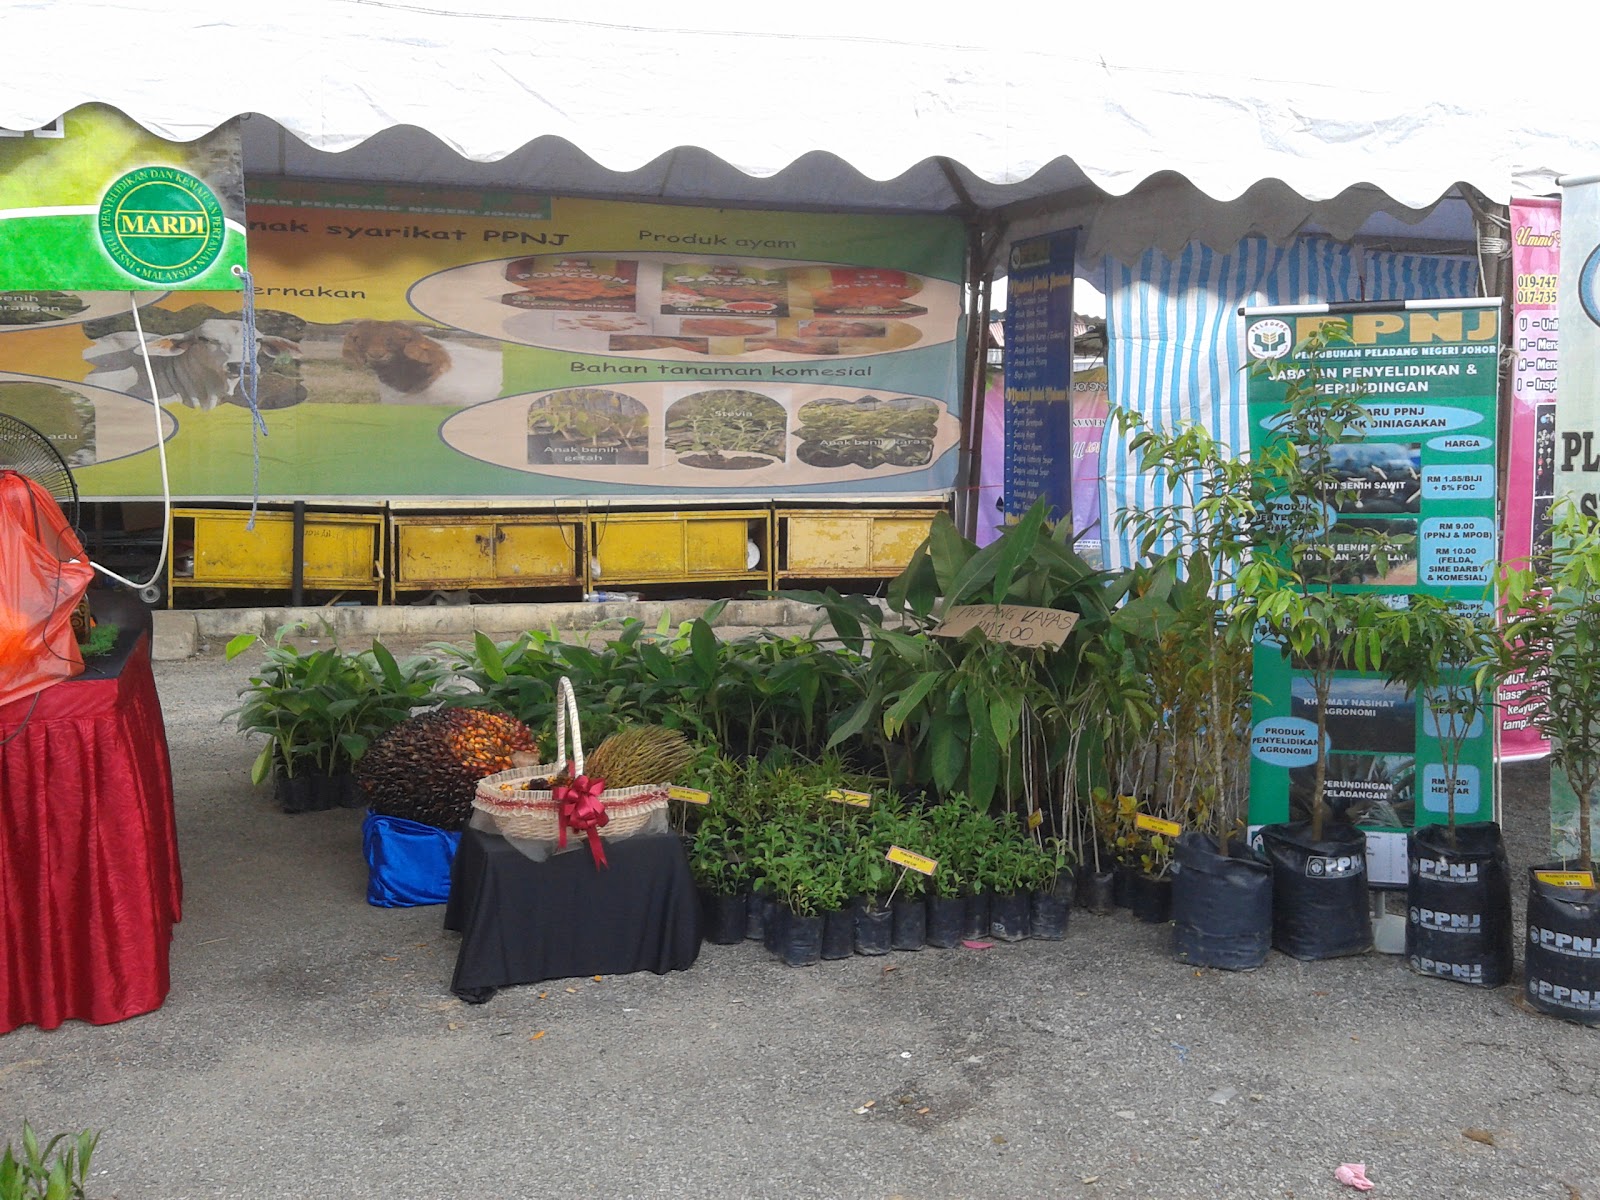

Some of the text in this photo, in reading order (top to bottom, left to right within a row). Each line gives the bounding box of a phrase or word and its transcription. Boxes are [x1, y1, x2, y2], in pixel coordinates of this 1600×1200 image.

[150, 169, 174, 181] DAN
[175, 173, 220, 215] KEMAJUAN
[121, 214, 206, 235] MARDI
[248, 219, 569, 247] nak syarikat PPNJ
[639, 230, 796, 249] Produk ayam
[142, 266, 196, 281] MALAYSIA
[516, 271, 630, 284] POPCORN
[1518, 275, 1557, 288] 019-747
[249, 285, 366, 300] ernakan
[1518, 291, 1557, 302] 017-735
[1296, 310, 1497, 345] PPNJ
[1364, 347, 1420, 358] PELADANG
[1422, 346, 1459, 356] NEGERI
[1461, 345, 1497, 355] JOHOR
[570, 361, 871, 377] Bahan tanaman komesial
[1342, 364, 1460, 378] PENYELIDIKAN
[1466, 363, 1477, 375] &
[714, 409, 753, 417] Stevia
[1362, 408, 1390, 416] ARU
[1394, 407, 1425, 416] PPNJ
[1371, 419, 1447, 428] DINIAGAKAN
[564, 454, 603, 463] getah
[1340, 481, 1371, 490] BENIH
[1374, 481, 1406, 490] SAWIT
[1275, 503, 1312, 511] RODUK
[1424, 532, 1451, 540] (PPNJ
[1462, 531, 1493, 540] MPOB)
[1337, 543, 1368, 551] BENIH
[1438, 556, 1474, 565] (FELDA,
[1428, 565, 1485, 573] SIME DARBY
[1436, 574, 1488, 582] KOMESIAL)
[1021, 610, 1073, 630] KAPAS
[1303, 699, 1396, 708] KHMAT NASIHAT
[1265, 727, 1306, 736] PRODUK
[1252, 737, 1319, 746] PENYELIDIKAN
[1259, 746, 1312, 755] AGRONOMI
[1323, 780, 1393, 791] PERUNDINGAN
[1322, 789, 1388, 800] PELADANGAN
[1325, 856, 1362, 872] PPN
[1419, 858, 1478, 877] PPNJ
[1420, 908, 1481, 928] PPNJ
[1420, 958, 1482, 978] PPNJ
